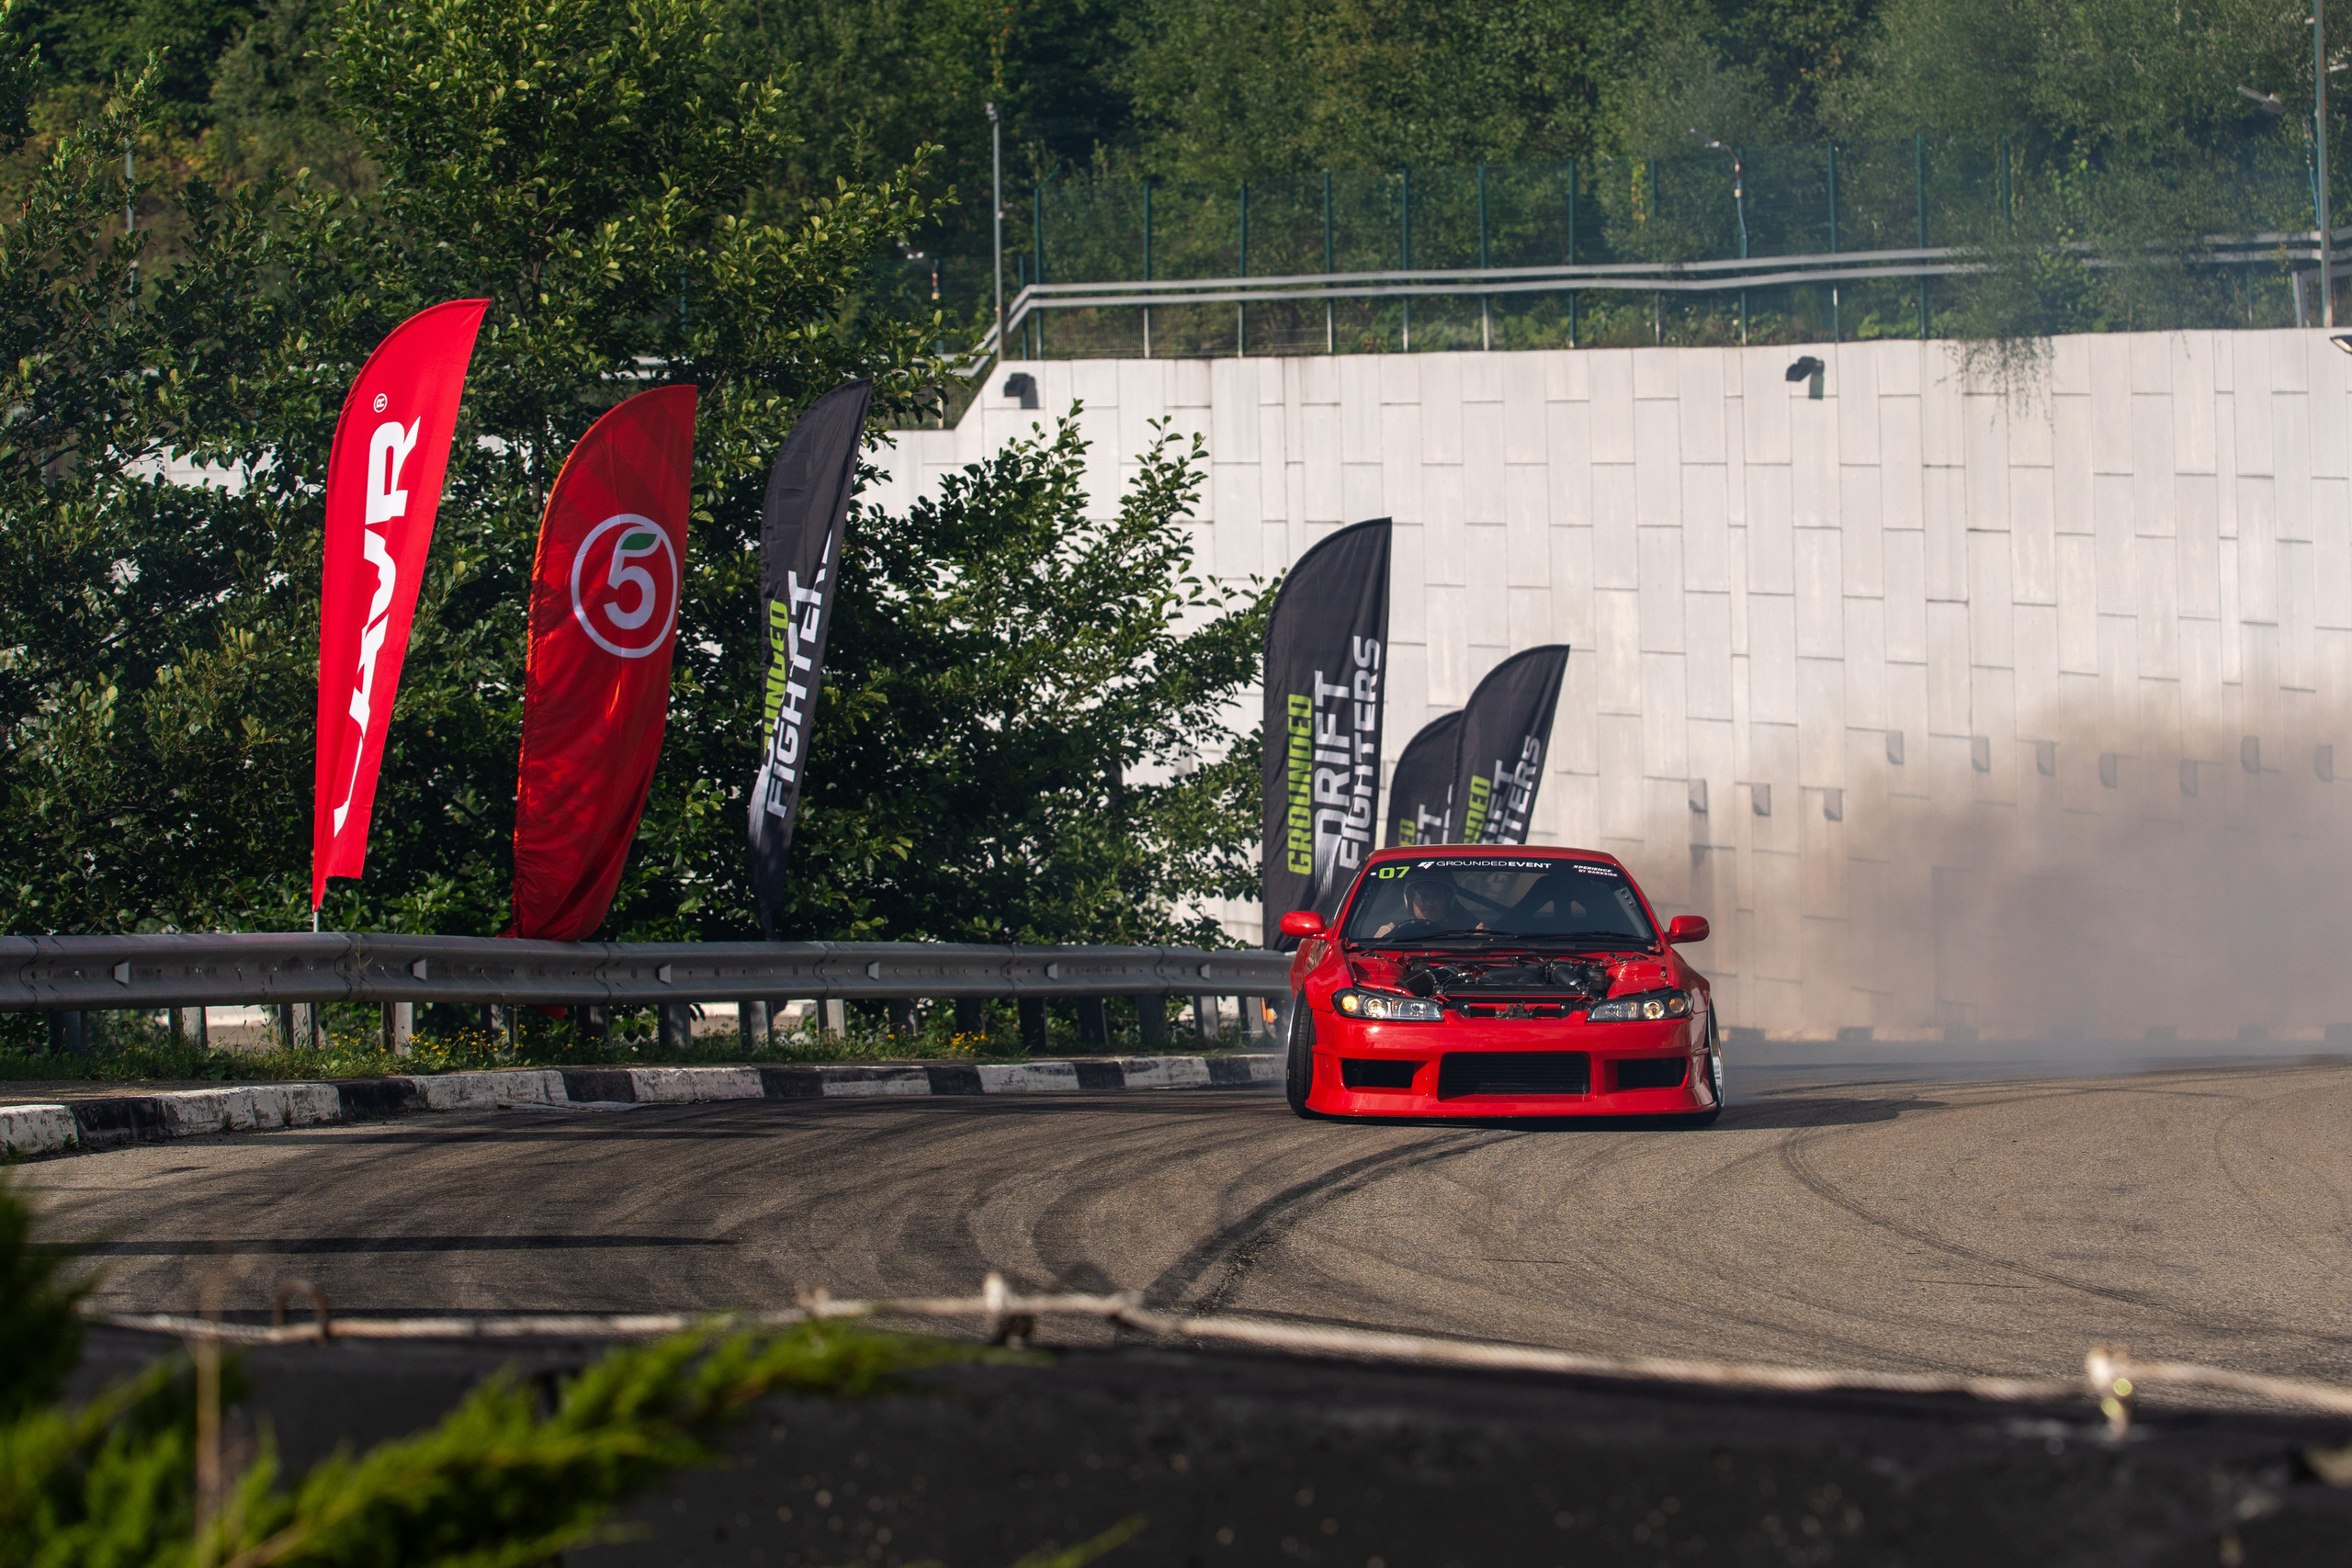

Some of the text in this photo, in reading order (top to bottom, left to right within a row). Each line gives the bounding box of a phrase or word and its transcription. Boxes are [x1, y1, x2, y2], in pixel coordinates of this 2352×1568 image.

[603, 525, 662, 630] 5
[1288, 694, 1312, 875] GROUNDED
[1315, 670, 1351, 893] DRIFT
[1339, 636, 1381, 869] FIGHTERS
[1378, 866, 1410, 879] 07
